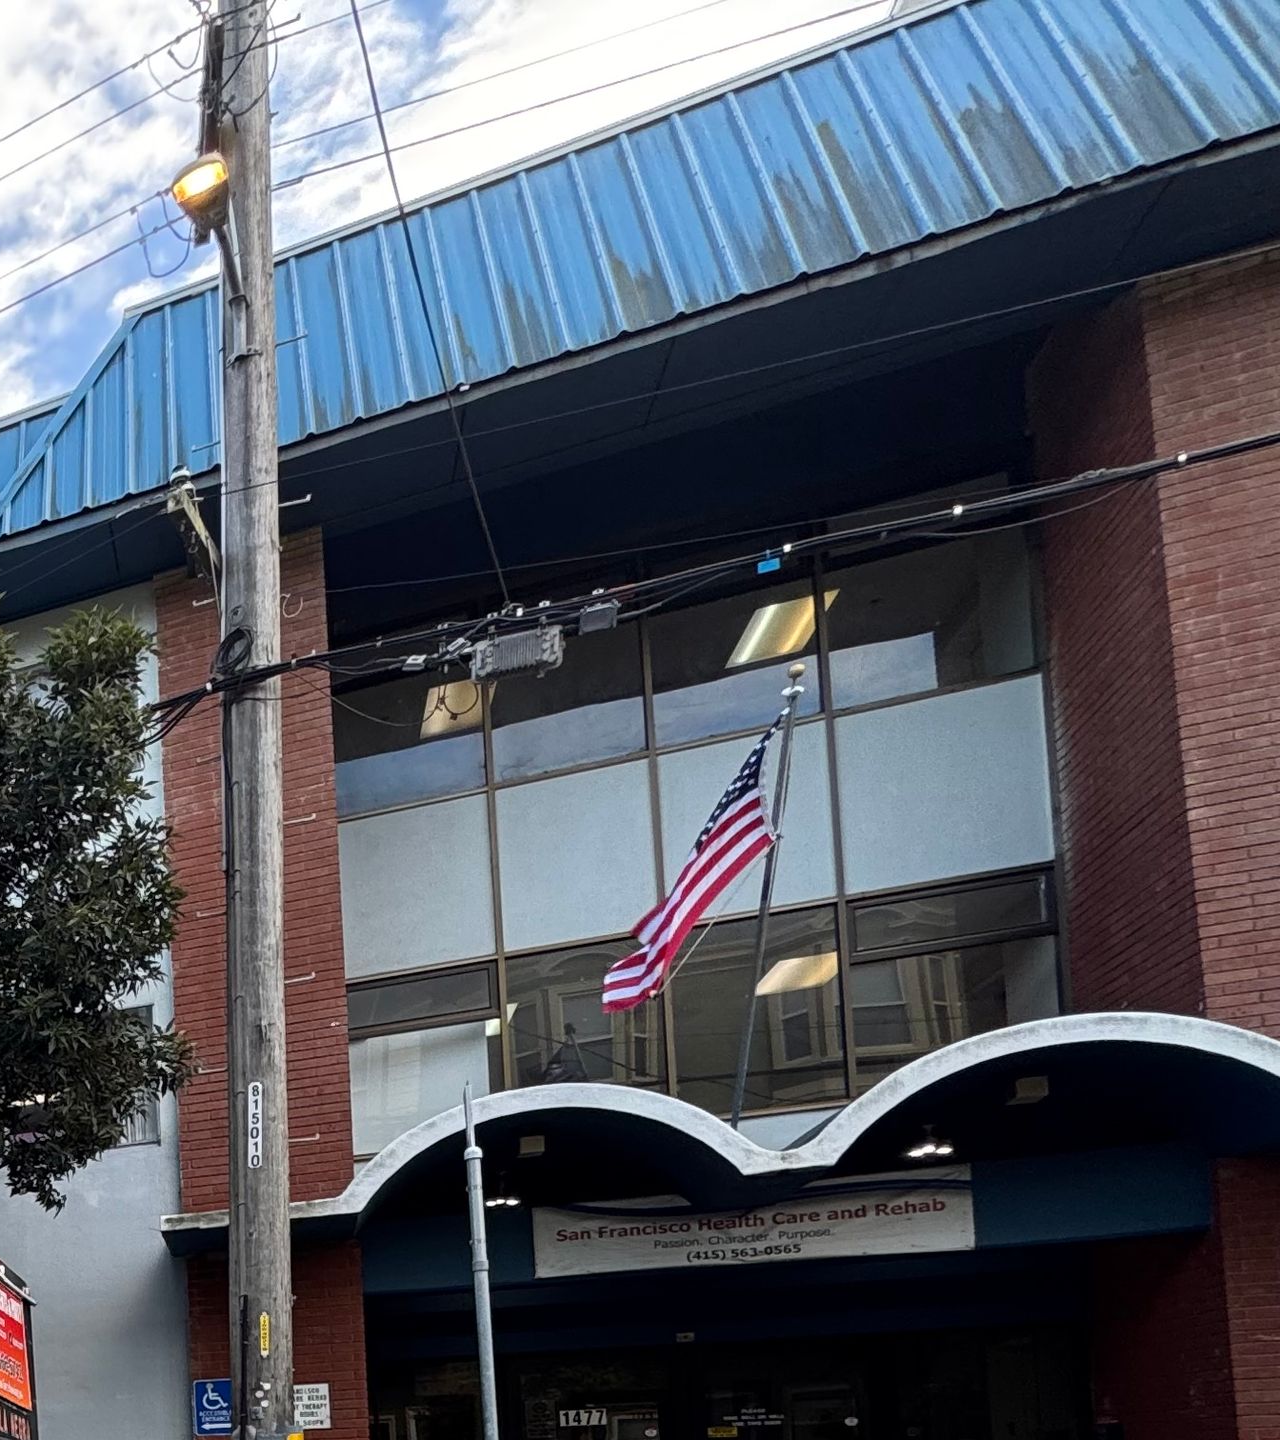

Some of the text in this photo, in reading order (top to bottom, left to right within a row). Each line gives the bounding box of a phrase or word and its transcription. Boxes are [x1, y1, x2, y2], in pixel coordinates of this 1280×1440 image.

[556, 1199, 946, 1242] San Francisco Health Care and Rehab
[654, 1238, 703, 1249] Passion.
[687, 1243, 802, 1262] (415) 563-0565
[562, 1409, 605, 1426] 1477
